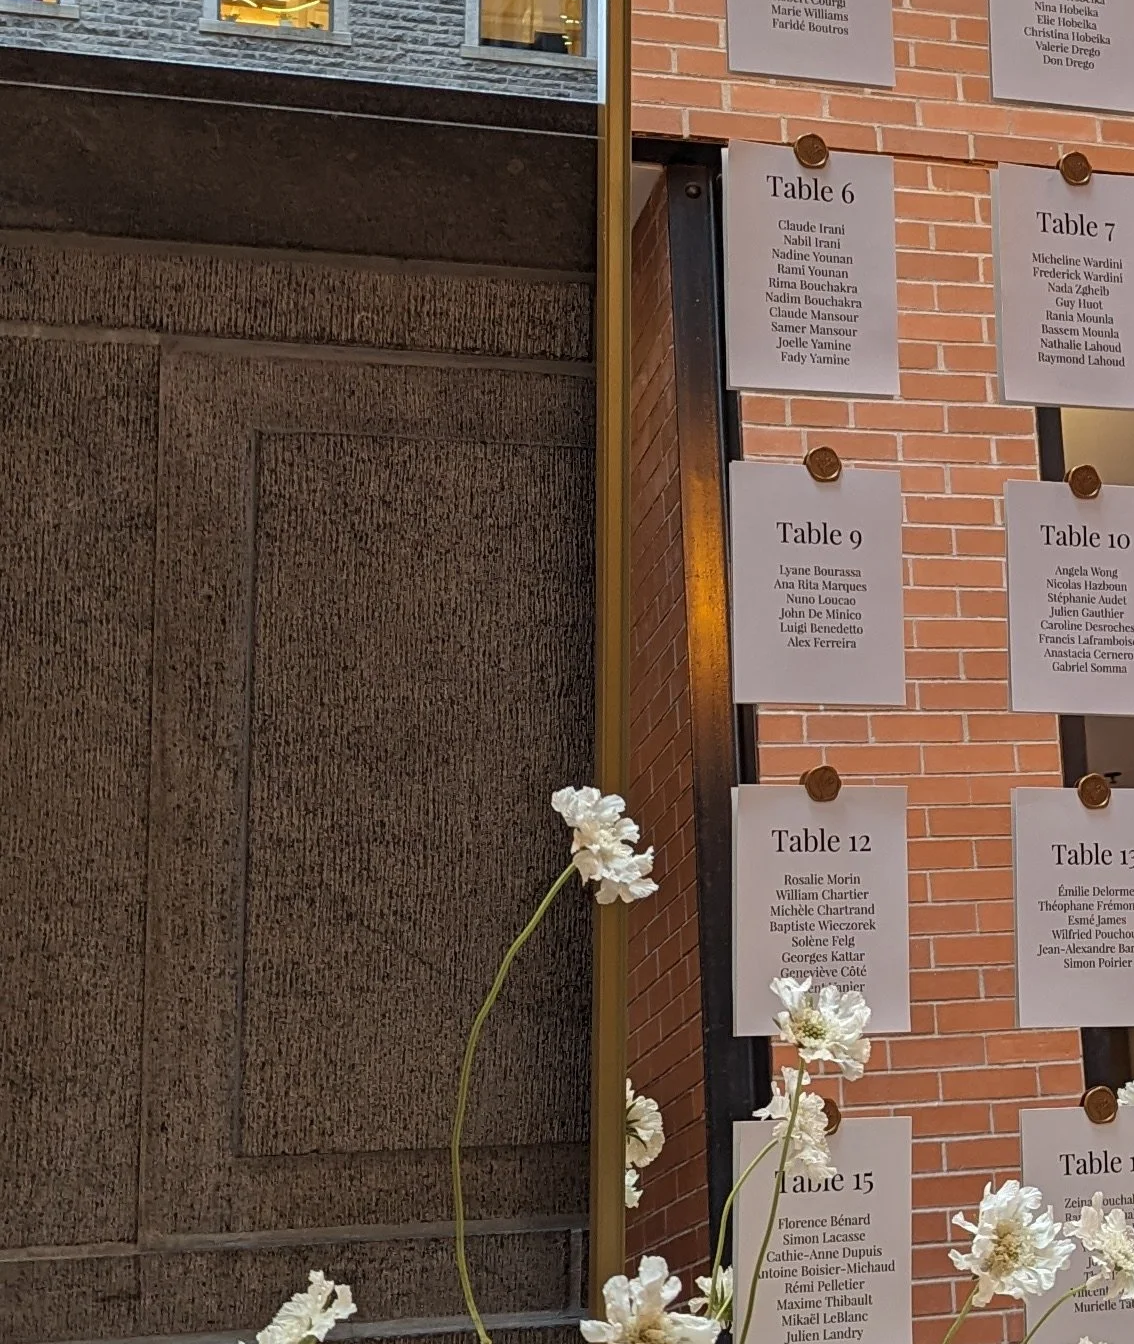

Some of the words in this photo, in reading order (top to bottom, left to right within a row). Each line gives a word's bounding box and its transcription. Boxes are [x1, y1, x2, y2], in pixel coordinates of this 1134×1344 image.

[772, 4, 801, 17] Marie
[804, 8, 848, 21] Williams
[1024, 26, 1069, 40] Christina
[1072, 32, 1110, 45] Hobeika
[1036, 40, 1069, 53] Valerie
[1072, 45, 1100, 58] Drego
[1043, 55, 1063, 66] Don
[1066, 57, 1094, 70] Drego
[766, 172, 833, 202] Table
[842, 182, 854, 204] 6
[778, 220, 816, 232] Claude
[820, 223, 845, 235] Irani
[1036, 212, 1098, 237] Table
[1105, 223, 1115, 242] 7
[784, 235, 811, 247] Nabil
[815, 237, 840, 249] Irani
[772, 248, 810, 261] Nadine
[812, 252, 853, 264] Younan
[769, 277, 797, 289] Rima
[800, 280, 858, 294] Bouchakra
[1048, 282, 1073, 294] Nada
[1056, 297, 1075, 310] Guy
[1078, 298, 1103, 310] Huot
[1038, 352, 1085, 365] Raymond
[1088, 355, 1125, 367] Lahoud
[776, 522, 842, 545] Table
[850, 530, 862, 550] 9
[1040, 524, 1100, 548] Table
[1108, 534, 1130, 549] 10
[814, 566, 861, 577] Bourassa
[1055, 566, 1088, 578] Angela
[1090, 567, 1118, 579] Wong
[1049, 606, 1079, 618] Julien
[1082, 608, 1124, 619] Gauthier
[780, 622, 807, 635] Luigi
[810, 623, 863, 634] Benedetto
[1041, 620, 1082, 631] Caroline
[1085, 622, 1134, 632] Desroches
[787, 636, 810, 647] Alex
[814, 637, 856, 648] Ferreira
[772, 828, 840, 852] Table
[849, 835, 871, 852] 12
[1052, 843, 1112, 865] Table
[784, 874, 824, 885] Rosalie
[827, 873, 860, 885] Morin
[776, 889, 818, 900] William
[822, 888, 869, 900] Chartier
[1058, 884, 1090, 896] Émilie
[1093, 886, 1134, 896] Delorme
[770, 904, 814, 916] Michèle
[817, 903, 874, 916] Chartrand
[1052, 928, 1092, 940] Wilfried
[782, 952, 828, 964] Georges
[831, 951, 865, 962] Kattar
[1064, 958, 1095, 968] Simon
[1098, 957, 1132, 968] Poirier
[1059, 1150, 1122, 1176] Table
[853, 1171, 873, 1194] 15
[1064, 1197, 1093, 1209] Zeina
[778, 1218, 827, 1230] Florence
[830, 1213, 870, 1226] Bénard
[783, 1233, 819, 1245] Simon
[823, 1232, 866, 1243] Lacasse
[785, 1281, 814, 1294] Rémi
[818, 1278, 865, 1292] Pelletier
[777, 1298, 822, 1311] Maxime
[825, 1294, 873, 1308] Thibault
[1074, 1301, 1117, 1313] Murielle
